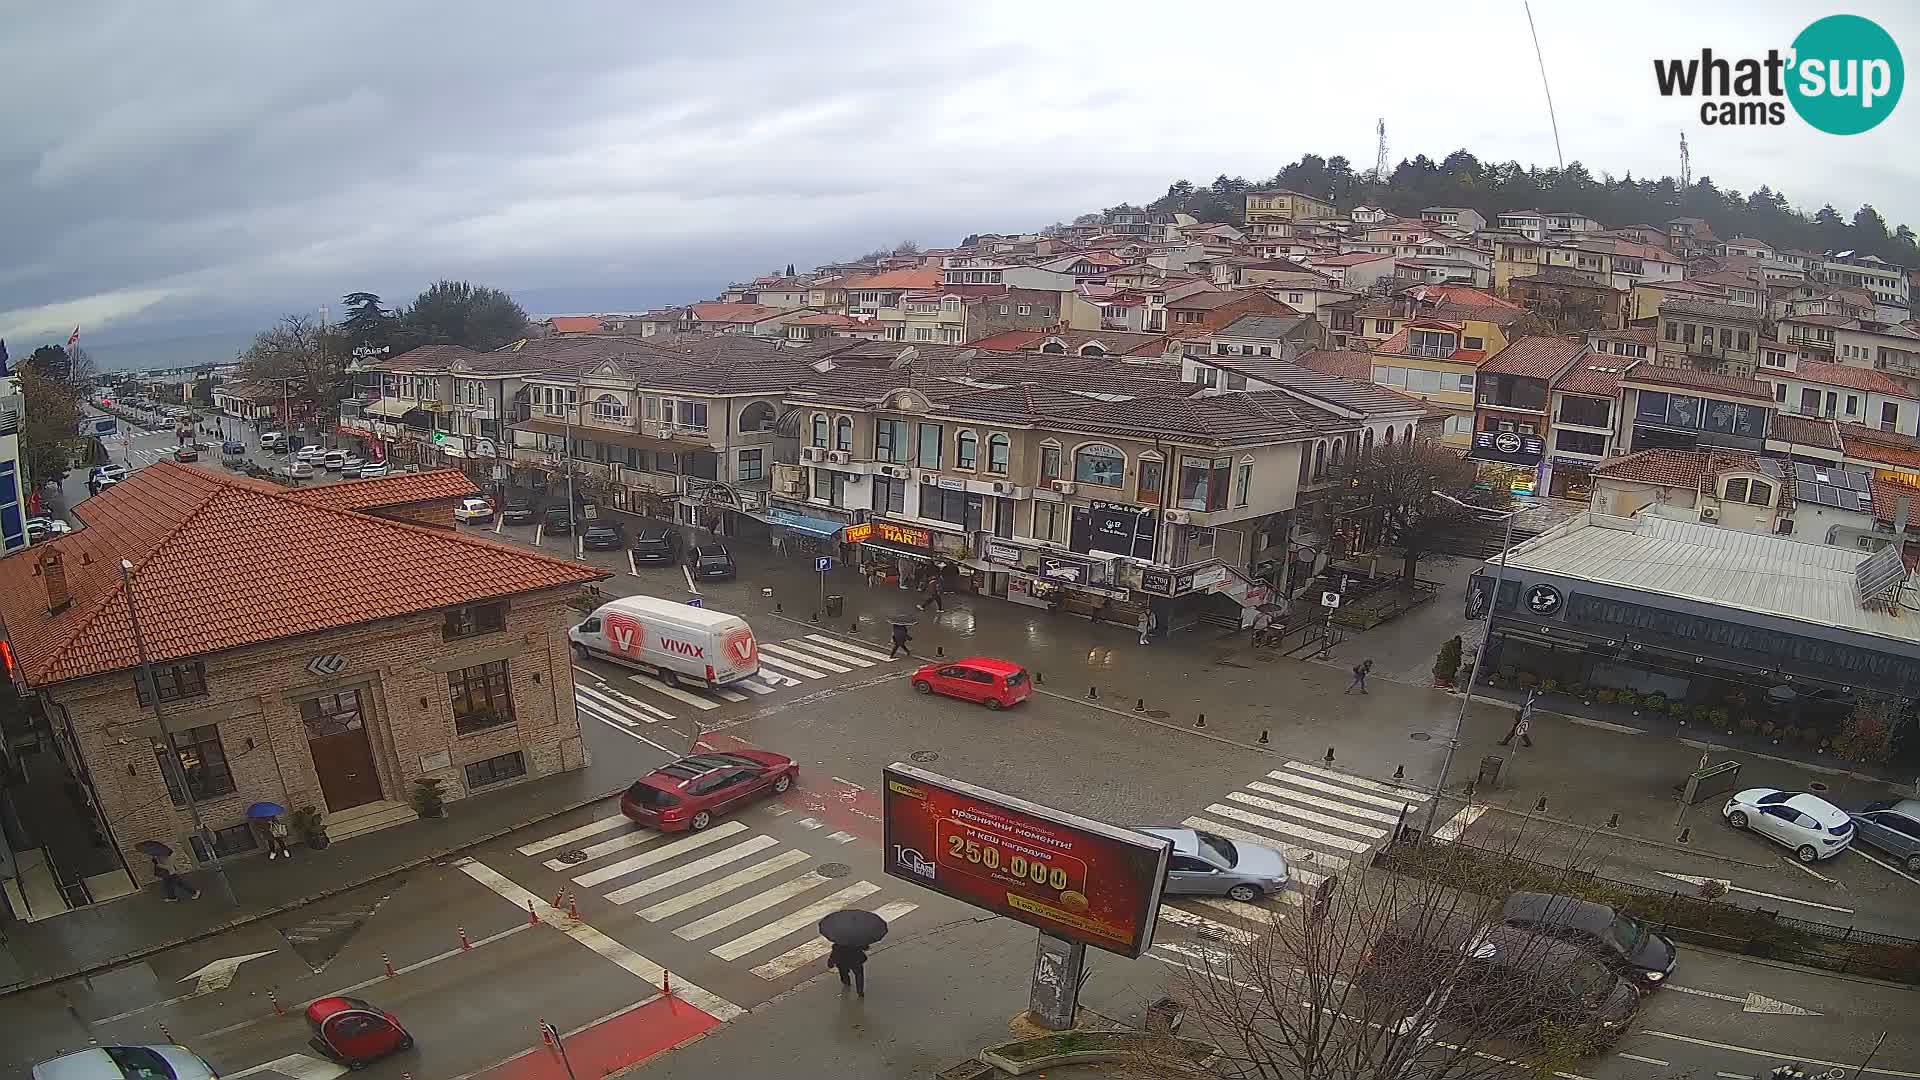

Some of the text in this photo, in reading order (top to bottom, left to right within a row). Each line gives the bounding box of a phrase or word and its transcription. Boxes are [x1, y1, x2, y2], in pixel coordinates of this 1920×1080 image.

[819, 559, 827, 569] P
[614, 626, 635, 651] V
[660, 637, 704, 658] VIVAX
[735, 638, 752, 660] V
[951, 808, 1073, 850] празнични моменти!
[948, 835, 1067, 890] 250.000
